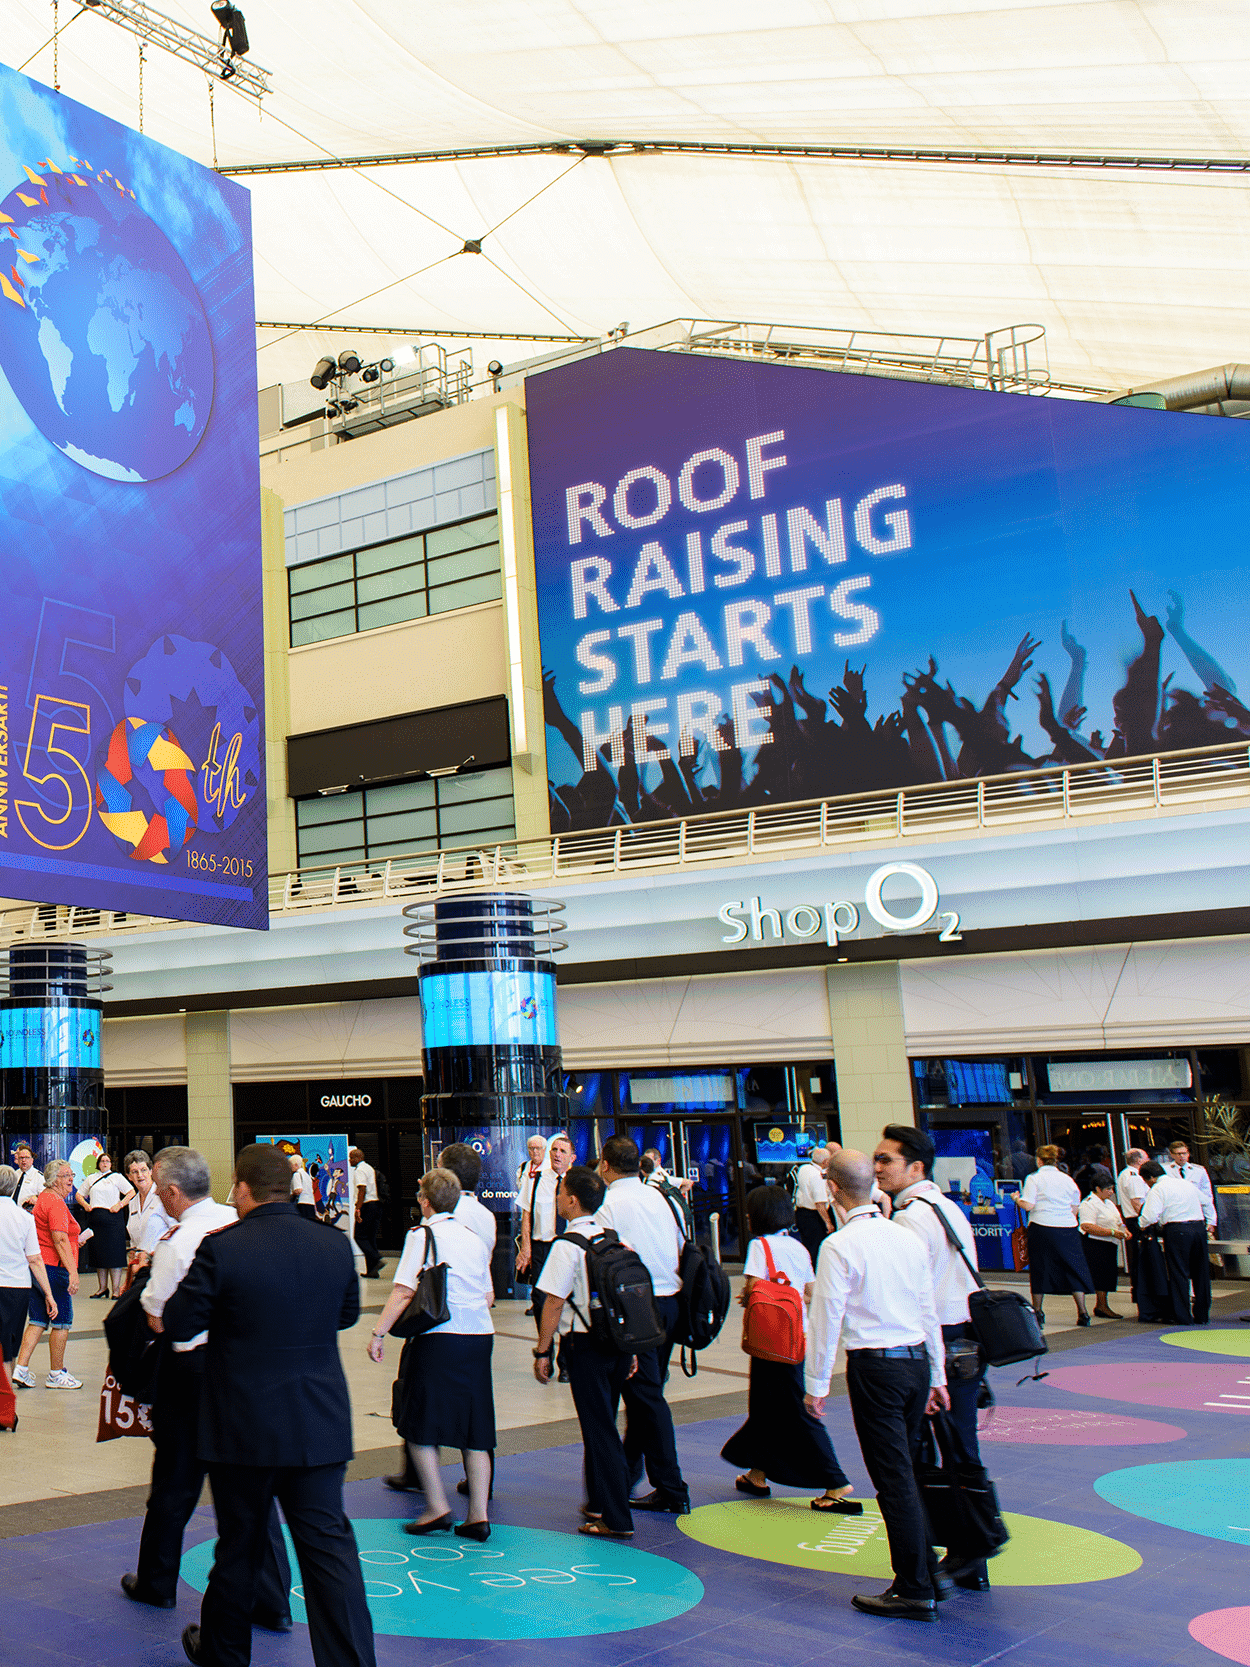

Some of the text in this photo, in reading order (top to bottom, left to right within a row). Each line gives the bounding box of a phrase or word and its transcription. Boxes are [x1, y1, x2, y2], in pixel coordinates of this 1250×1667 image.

[565, 430, 788, 545] ROOF
[570, 484, 912, 620] RAISING
[576, 575, 879, 695] STARTS
[580, 679, 775, 773] HERE
[185, 849, 254, 878] 1865-2015
[718, 896, 860, 947] Shop
[320, 1094, 372, 1107] GAUCHO
[481, 1189, 494, 1199] do
[971, 1226, 1012, 1237] IORITY
